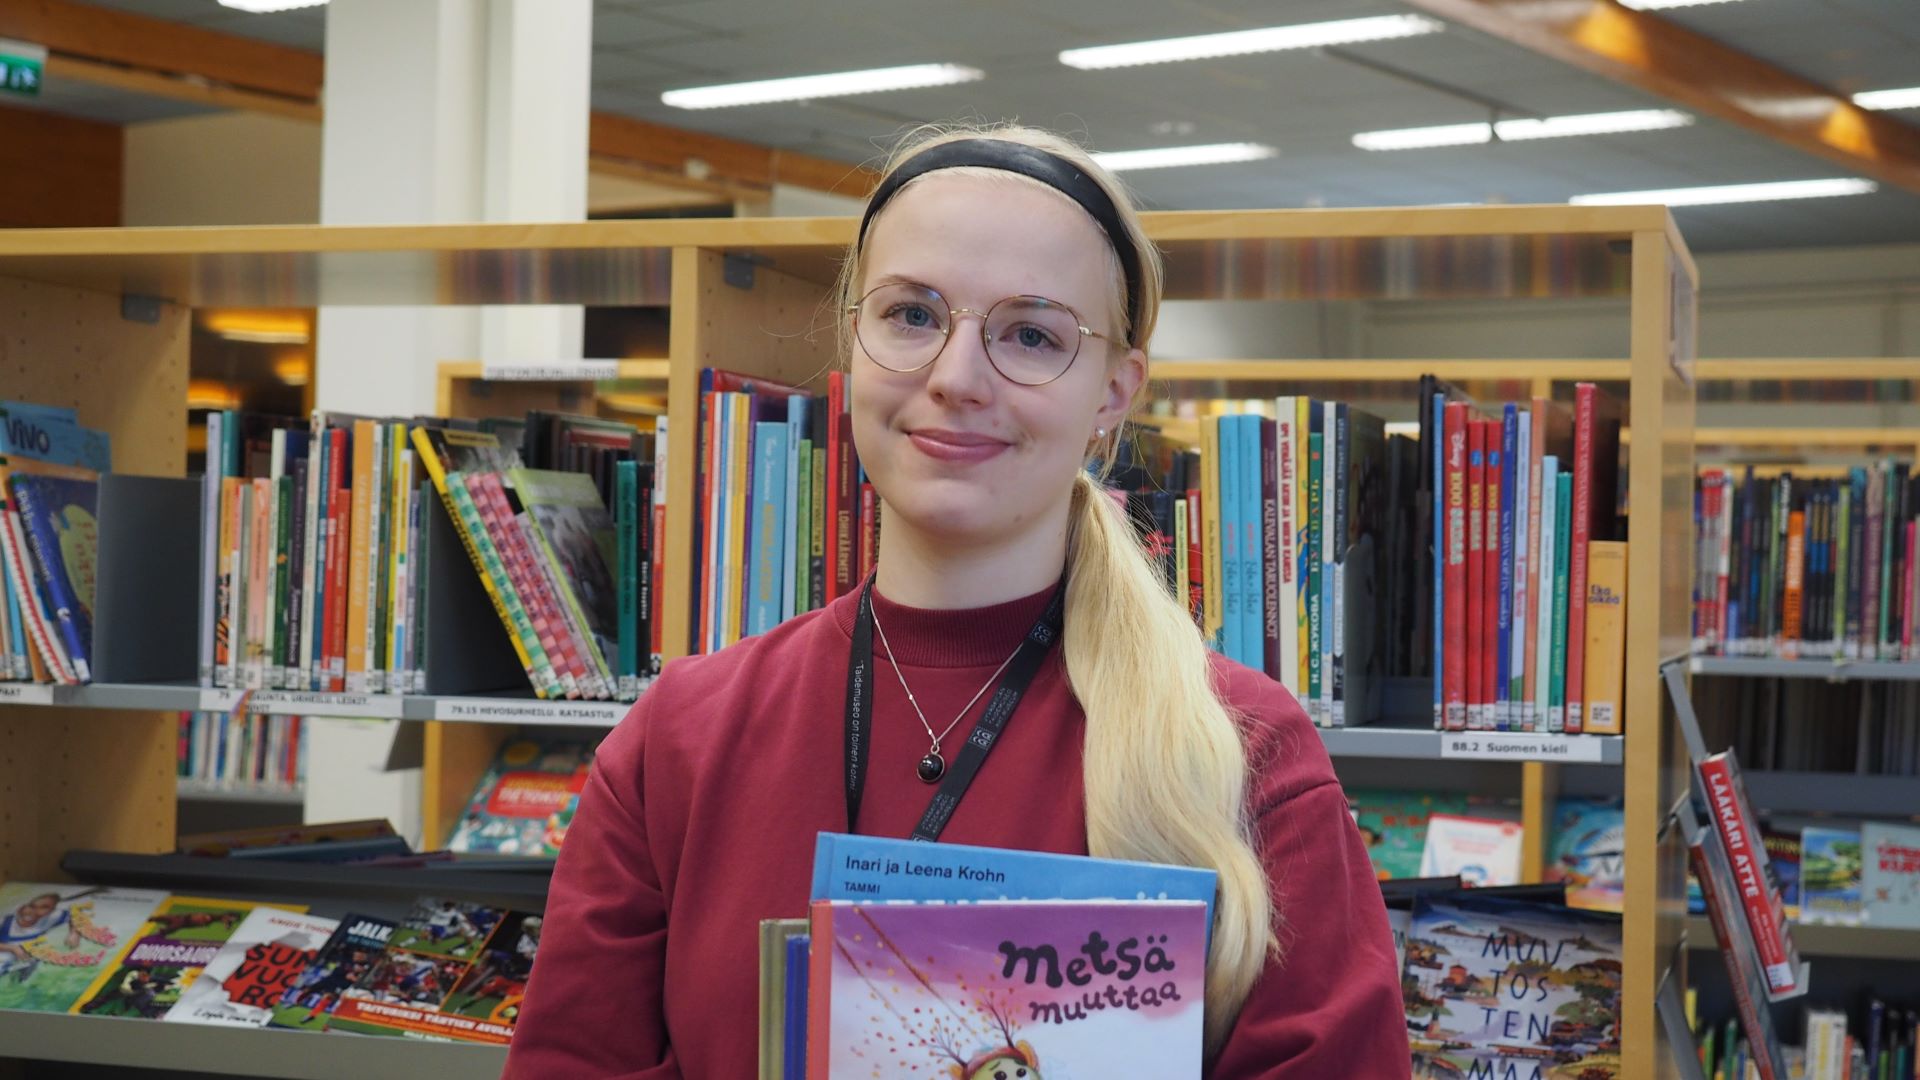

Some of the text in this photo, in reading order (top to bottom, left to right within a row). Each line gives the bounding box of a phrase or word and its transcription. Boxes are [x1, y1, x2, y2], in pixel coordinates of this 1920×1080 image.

[1451, 472, 1463, 505] 1000
[1264, 498, 1277, 559] KALEVALAN
[1310, 479, 1320, 573] БУКВАРЬ
[837, 509, 849, 585] LOHIKÄÄRMEET
[1311, 594, 1320, 652] ЖУКОВА
[559, 709, 615, 719] RATSASTUS
[852, 719, 859, 731] on
[851, 733, 861, 762] toinen
[1452, 742, 1568, 754] 88.2 Suomen kieli
[845, 855, 1006, 883] Inari ja Leena Krohn
[1734, 852, 1760, 899] ATTE
[844, 881, 881, 894] TAMMI
[347, 919, 394, 941] JALK
[1481, 932, 1568, 966] MUU
[1489, 968, 1549, 1002] TOS
[1029, 980, 1181, 1025] muuttaa
[1479, 1006, 1550, 1041] TEN
